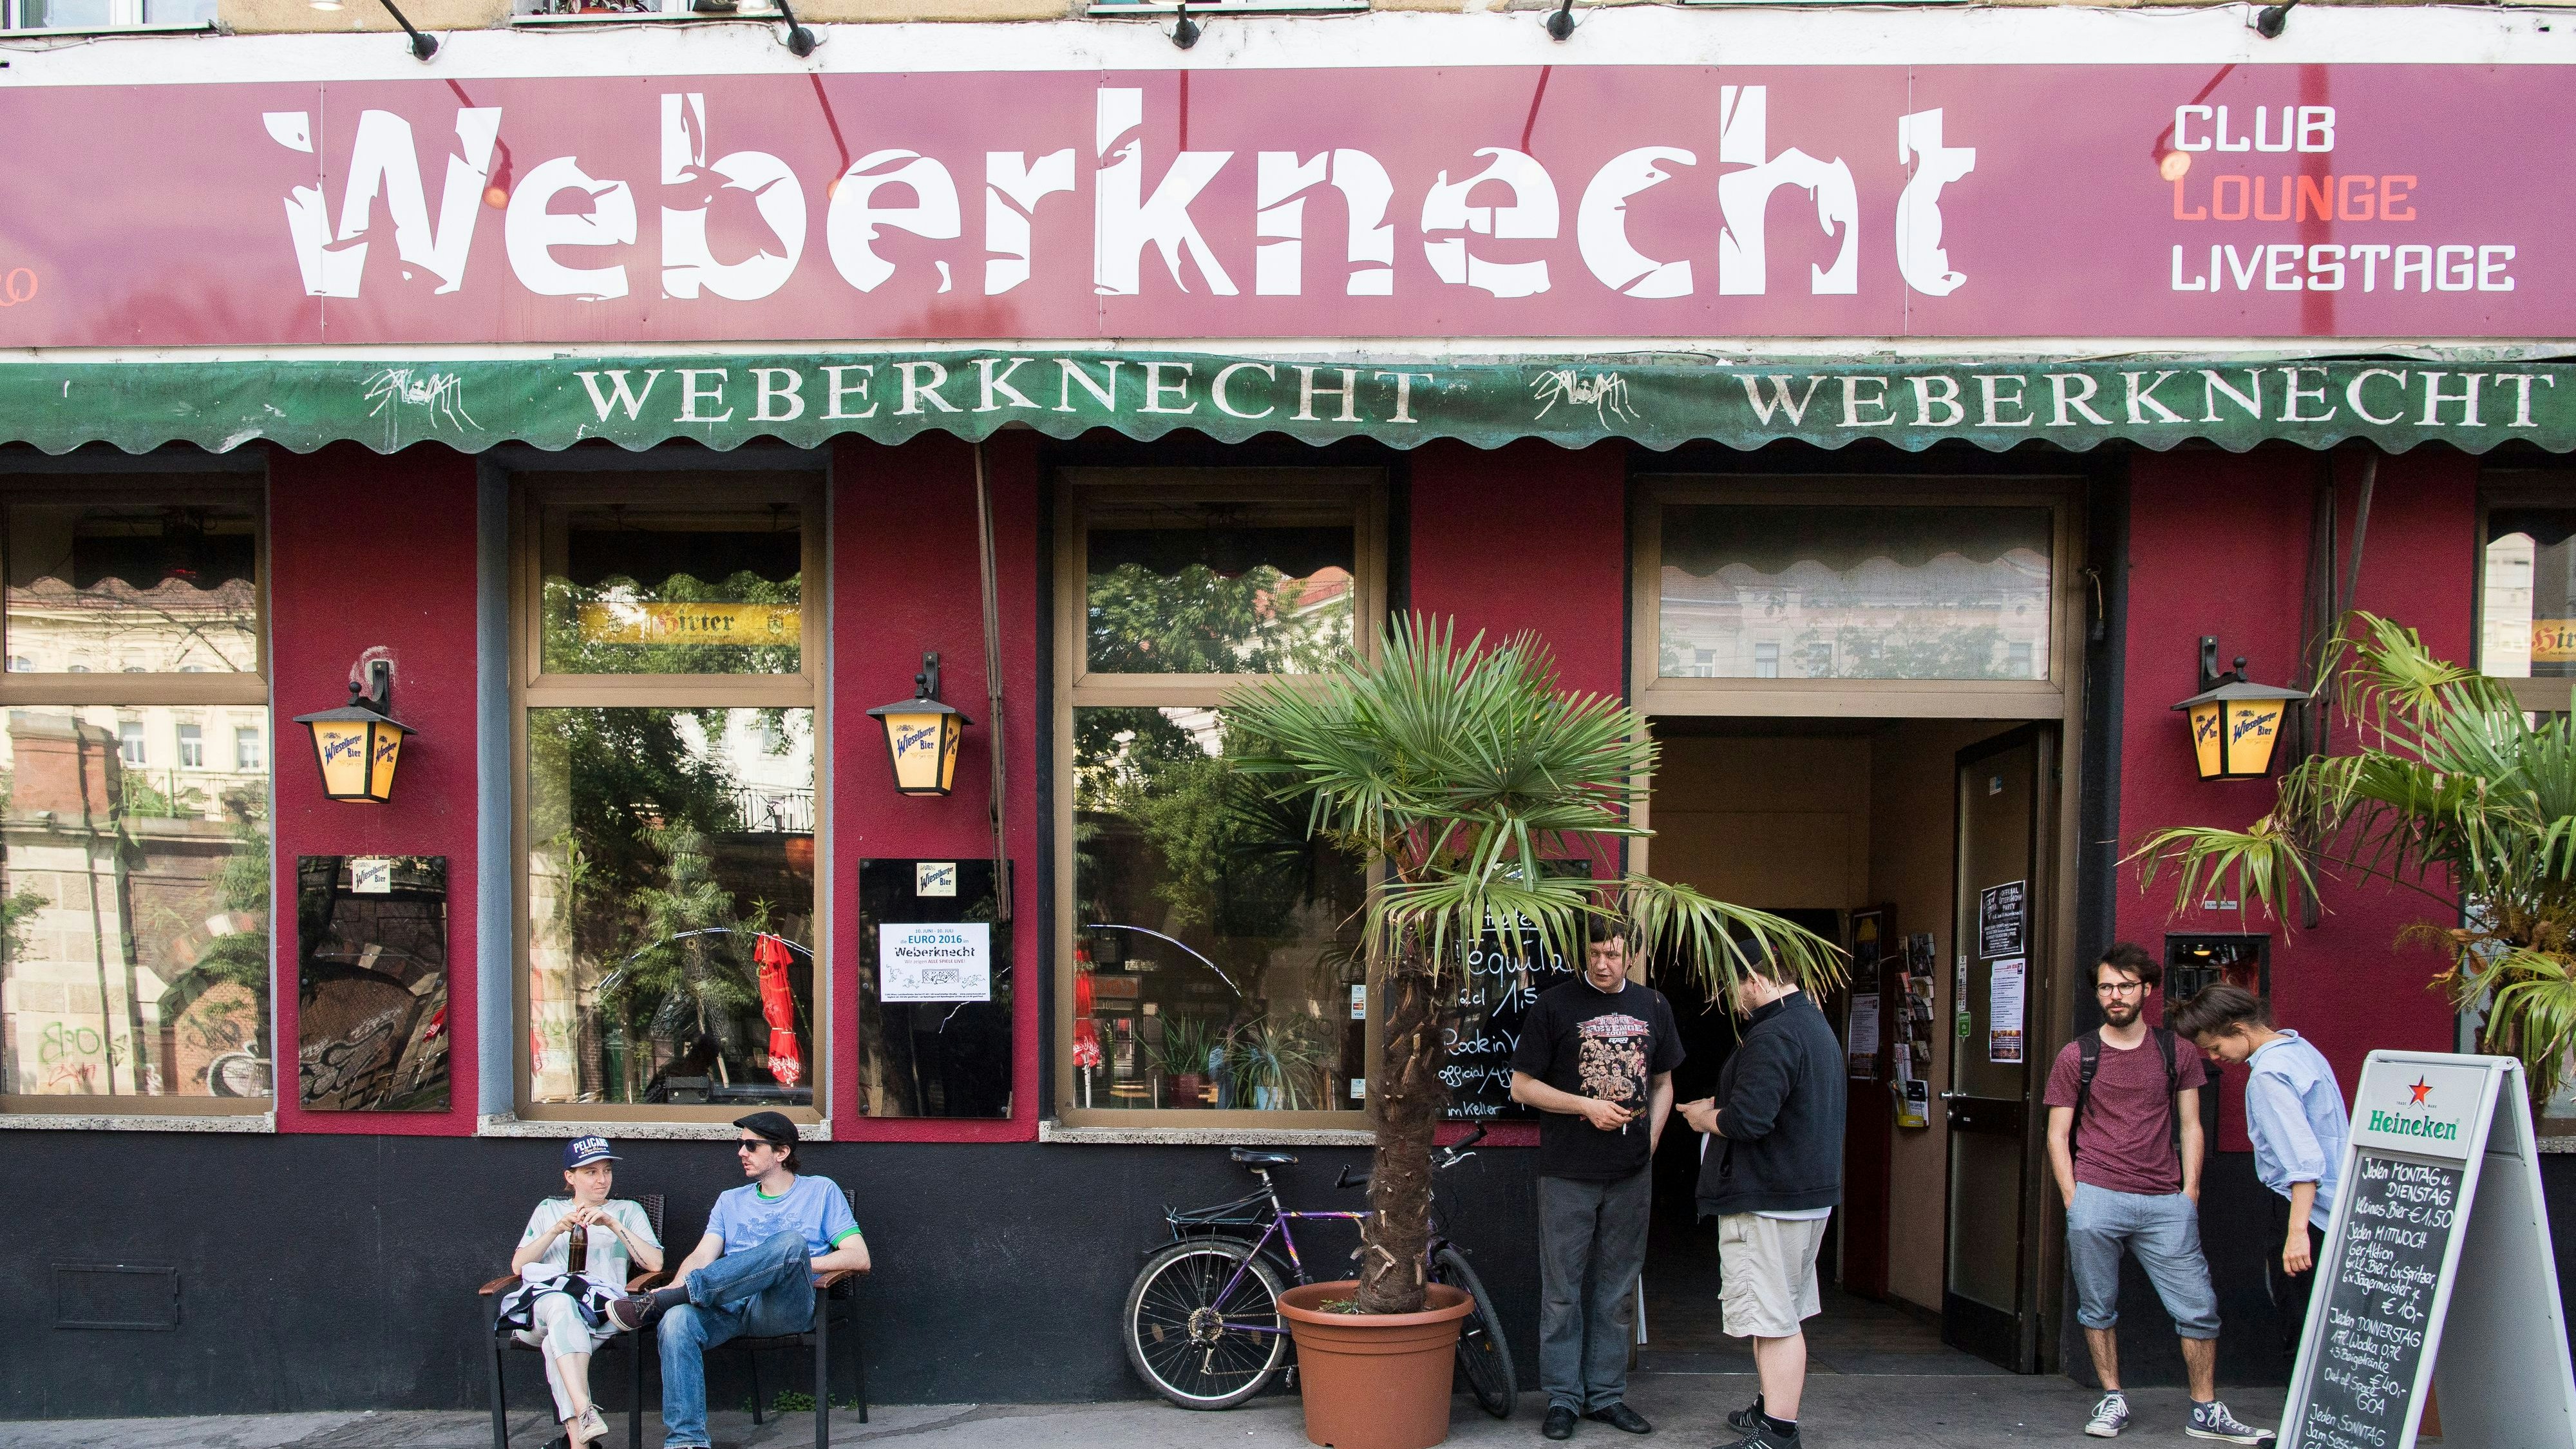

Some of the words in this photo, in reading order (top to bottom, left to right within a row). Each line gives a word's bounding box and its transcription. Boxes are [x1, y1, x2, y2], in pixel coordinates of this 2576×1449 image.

[2174, 104, 2336, 153] CLUB
[261, 84, 1977, 301] Weberknecht
[2173, 175, 2418, 222] LOUNGE
[2172, 243, 2517, 294] LIVESTAGE
[573, 356, 1434, 425] WEBERKNECHT
[1732, 366, 2555, 429] WEBERKNECHT
[2232, 712, 2277, 746] Wieselburger
[2257, 726, 2272, 735] Bier
[324, 735, 362, 766] Wieselburger
[348, 748, 361, 757] Bier
[896, 726, 936, 760] Wieselburger
[920, 740, 934, 750] Bier
[355, 864, 388, 890] Wieselburger
[920, 867, 954, 893] Wieselburger
[940, 877, 952, 886] Bier
[895, 947, 976, 957] Weberknecht
[908, 935, 936, 943] EURO
[938, 935, 962, 943] 2016
[1586, 1024, 1643, 1032] REVENGE
[1444, 1028, 1492, 1056] Rock
[1492, 1036, 1507, 1054] in
[1438, 1064, 1484, 1087] official
[1447, 1103, 1463, 1117] im
[1463, 1101, 1507, 1115] Keller
[2367, 1109, 2457, 1141] Heineken
[573, 1137, 609, 1153] PELICANS
[2362, 1158, 2389, 1180] Jeden
[2391, 1162, 2440, 1186] MONTAG
[2441, 1175, 2451, 1186] u.
[2385, 1182, 2452, 1206] DIENSTAG
[2386, 1200, 2410, 1219] Bier
[2347, 1222, 2371, 1240] Jeden
[2375, 1226, 2427, 1249] MITTWOCH
[2364, 1241, 2394, 1261] Aktion
[2354, 1271, 2412, 1296] Jägermeister
[2410, 1287, 2420, 1305] je
[2329, 1307, 2354, 1329] Jeden
[2357, 1316, 2421, 1348] DONNERSTAG
[2349, 1332, 2379, 1356] Wodka
[2340, 1347, 2390, 1374] Beigetränke
[2324, 1367, 2341, 1384] Out
[2339, 1372, 2351, 1393] of
[2351, 1376, 2378, 1399] Space
[2310, 1403, 2336, 1426] Jeden
[2357, 1393, 2385, 1416] GOA
[2306, 1421, 2326, 1442] Jam
